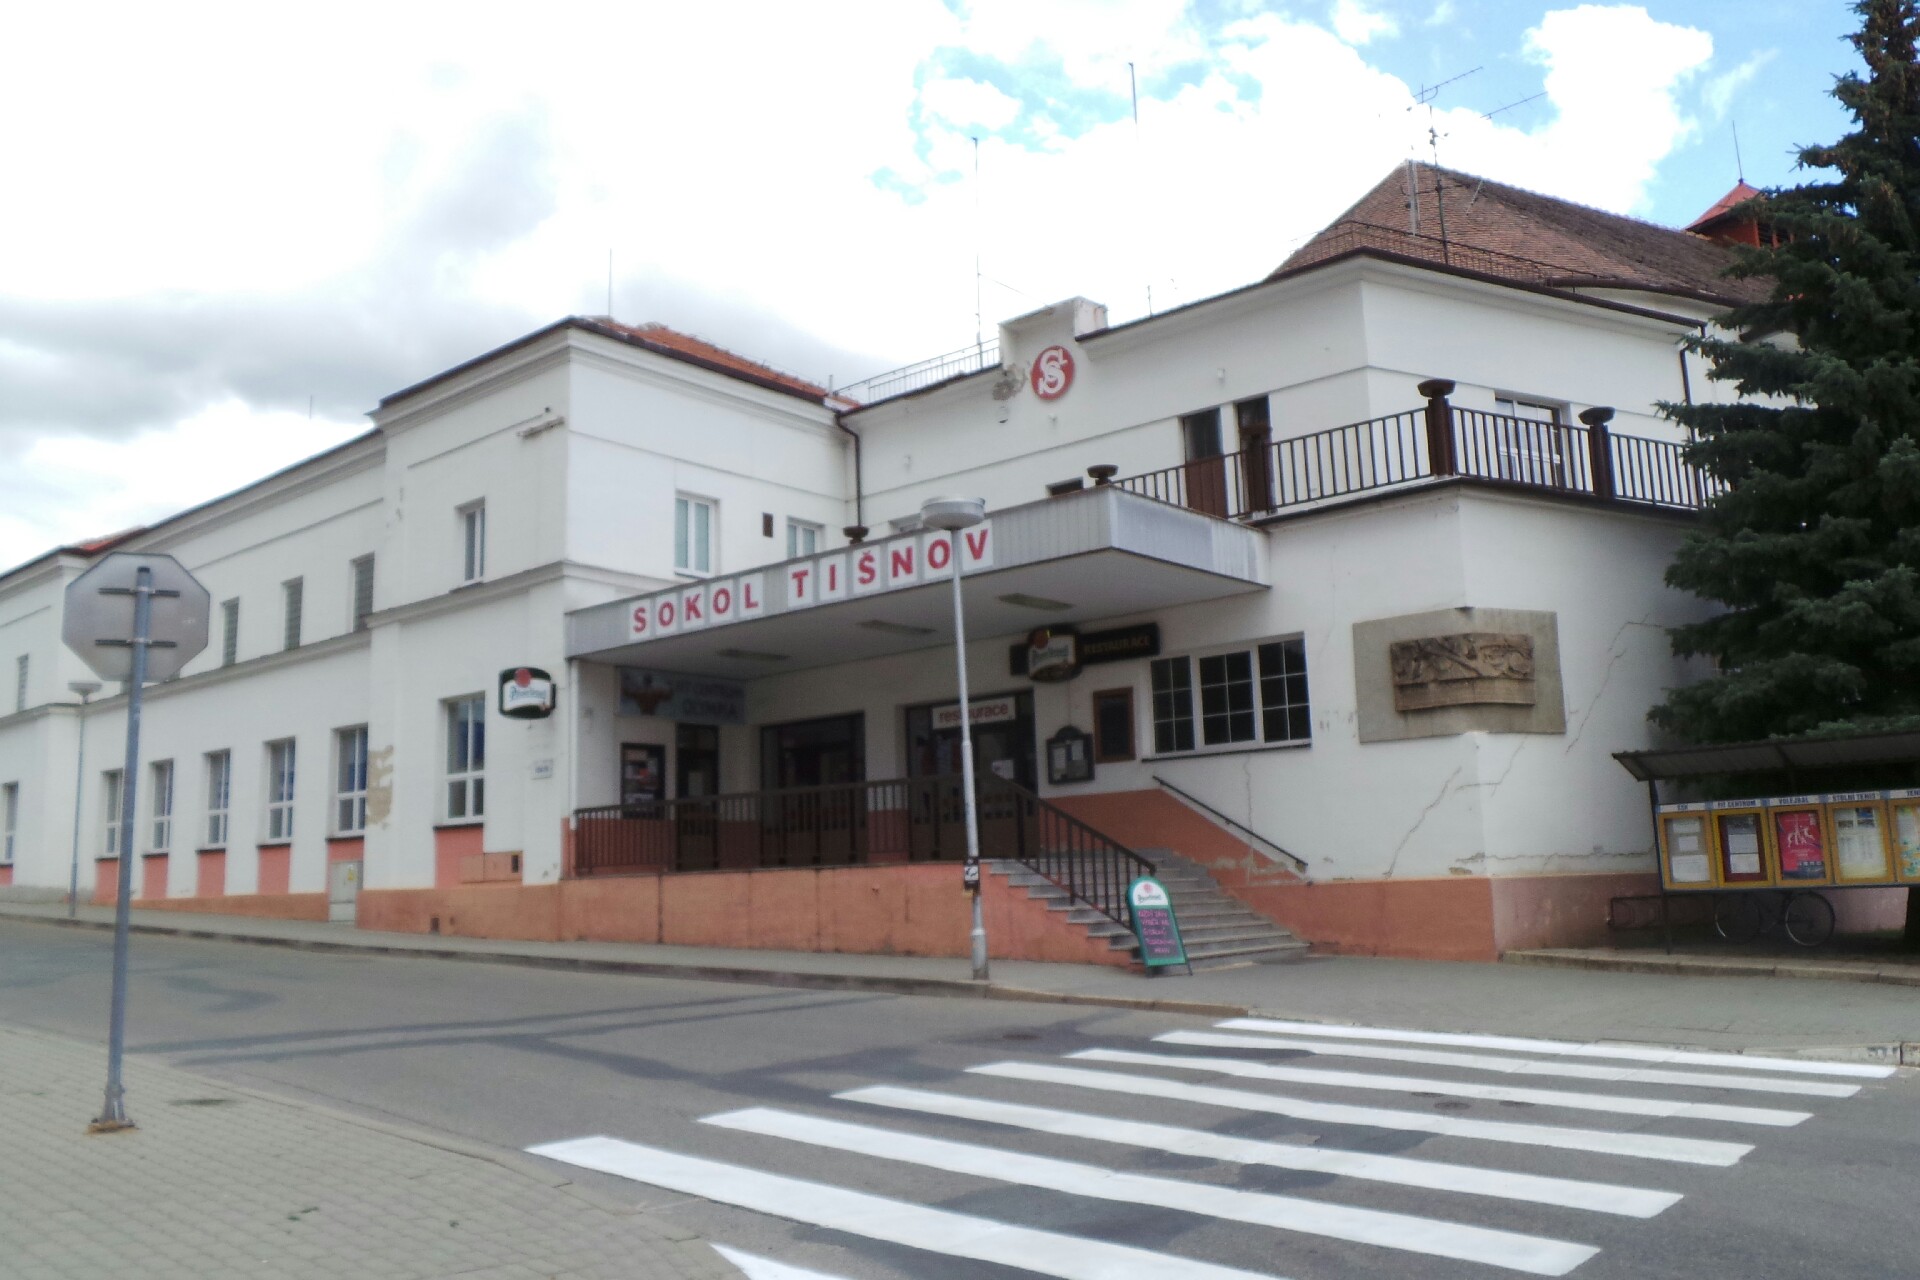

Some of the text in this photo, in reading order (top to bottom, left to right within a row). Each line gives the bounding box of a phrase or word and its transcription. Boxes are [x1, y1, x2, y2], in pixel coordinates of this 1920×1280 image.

[632, 528, 990, 634] SOKOL TIŠNOV
[1083, 634, 1151, 656] RESTAURACE
[938, 702, 1009, 723] resurace
